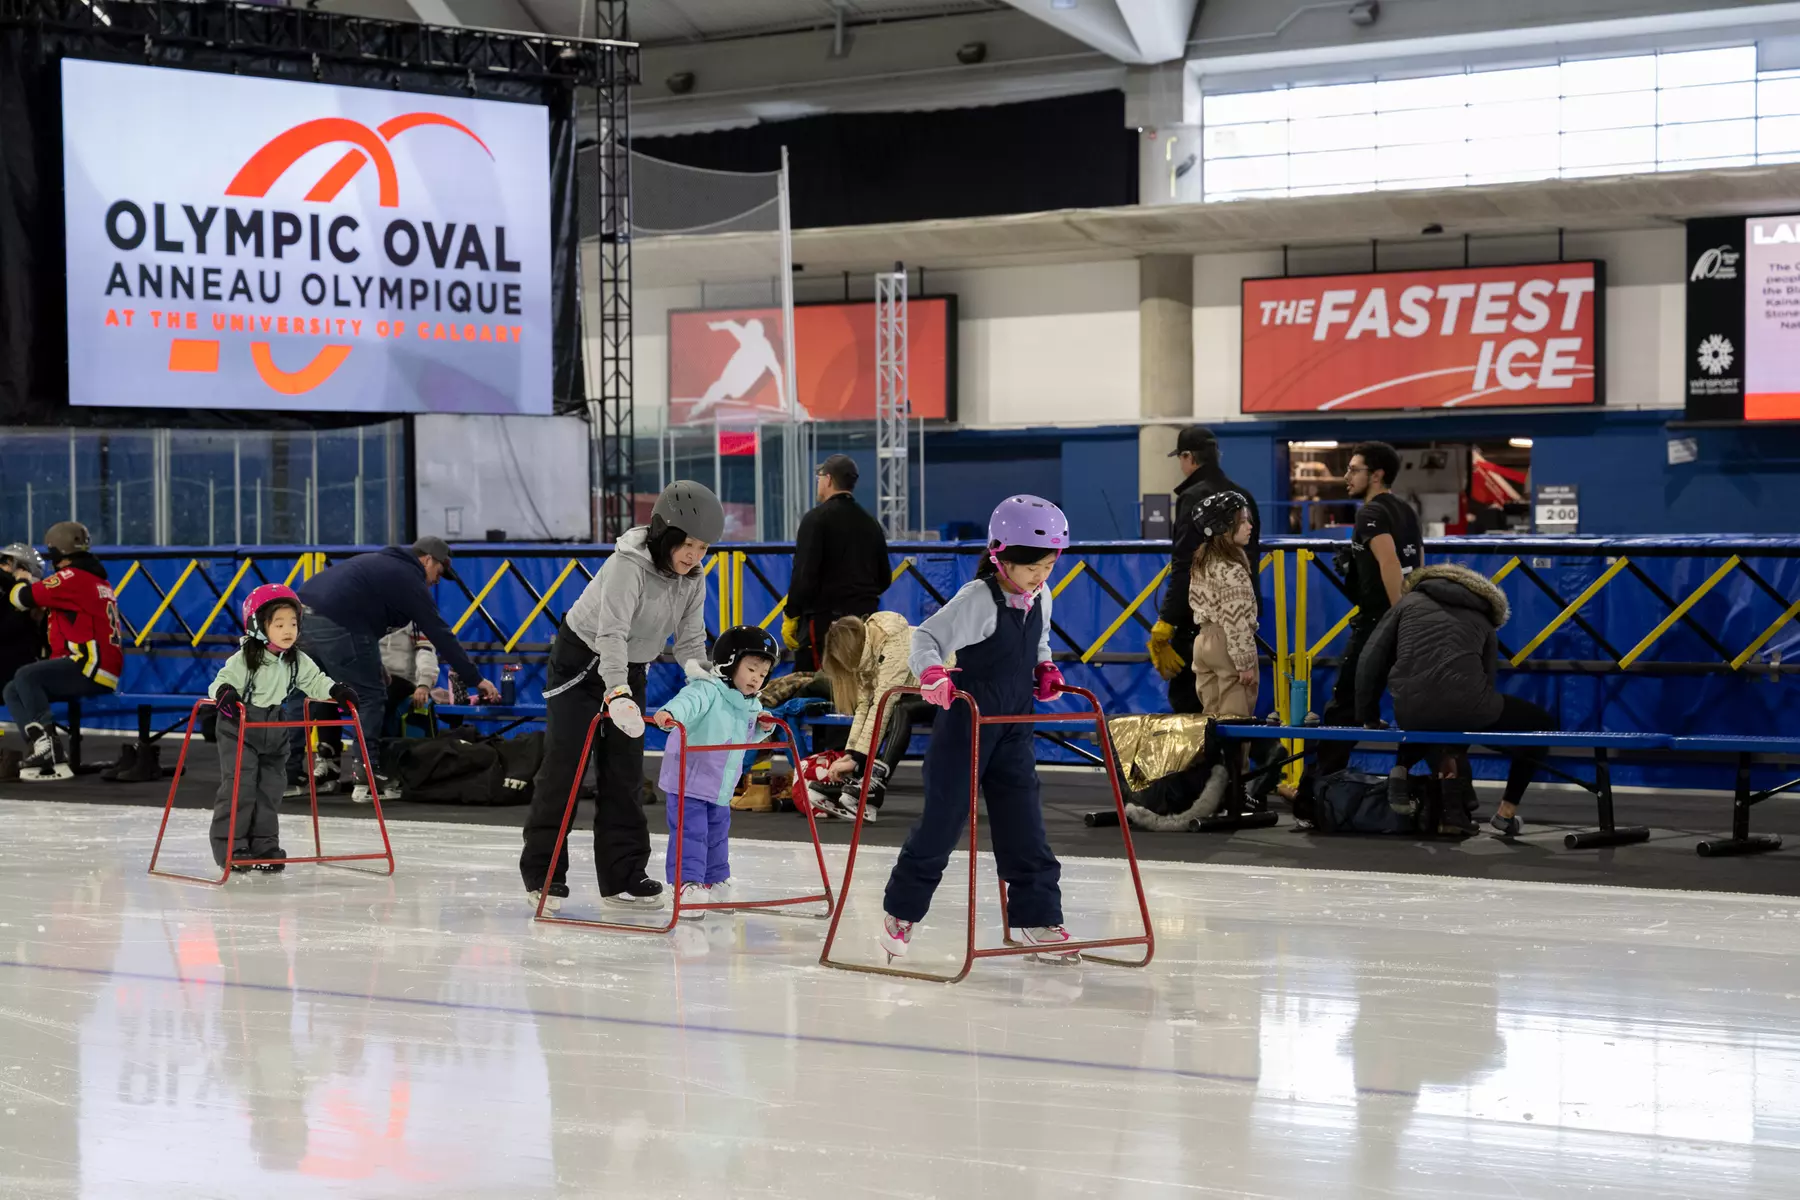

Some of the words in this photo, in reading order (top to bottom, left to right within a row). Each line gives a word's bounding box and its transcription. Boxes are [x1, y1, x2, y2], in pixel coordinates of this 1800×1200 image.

[105, 199, 360, 264] OLYMPIC
[384, 219, 522, 273] OVAL
[1754, 223, 1800, 245] LA
[104, 262, 281, 303] ANNEAU
[301, 273, 522, 315] OLYMPIQUE
[1259, 299, 1315, 325] THE
[1313, 277, 1594, 341] FASTEST
[104, 308, 135, 328] AT
[150, 310, 197, 330] THE
[212, 313, 362, 337] UNIVERSITY
[377, 320, 405, 339] OF
[418, 321, 523, 344] CALGARY
[1472, 338, 1582, 391] ICE
